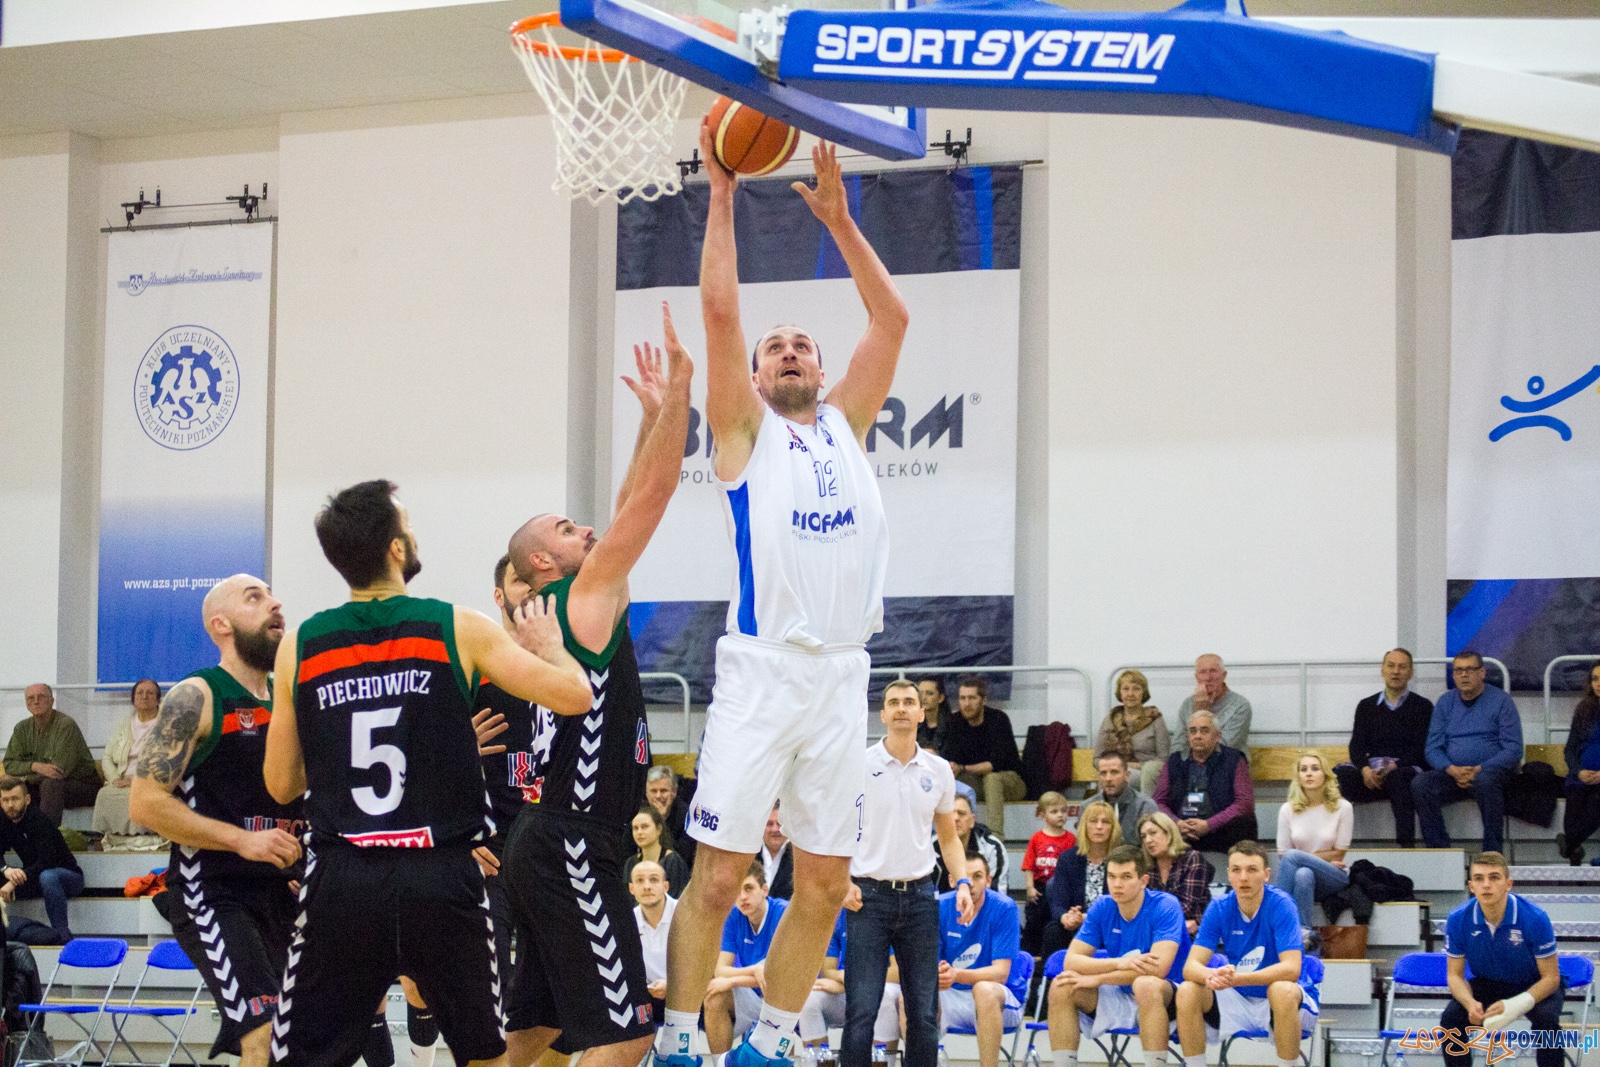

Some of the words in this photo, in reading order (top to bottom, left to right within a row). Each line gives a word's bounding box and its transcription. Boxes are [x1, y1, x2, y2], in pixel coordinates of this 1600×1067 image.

[815, 24, 1176, 72] SPORTSYSTEM
[146, 341, 167, 370] KLUB
[169, 332, 231, 366] UCZELNIANY
[140, 385, 184, 444] POLITECHNIKI
[877, 459, 938, 478] LEKÓW
[316, 669, 432, 711] PIECHOWICZ
[351, 706, 407, 816] 5
